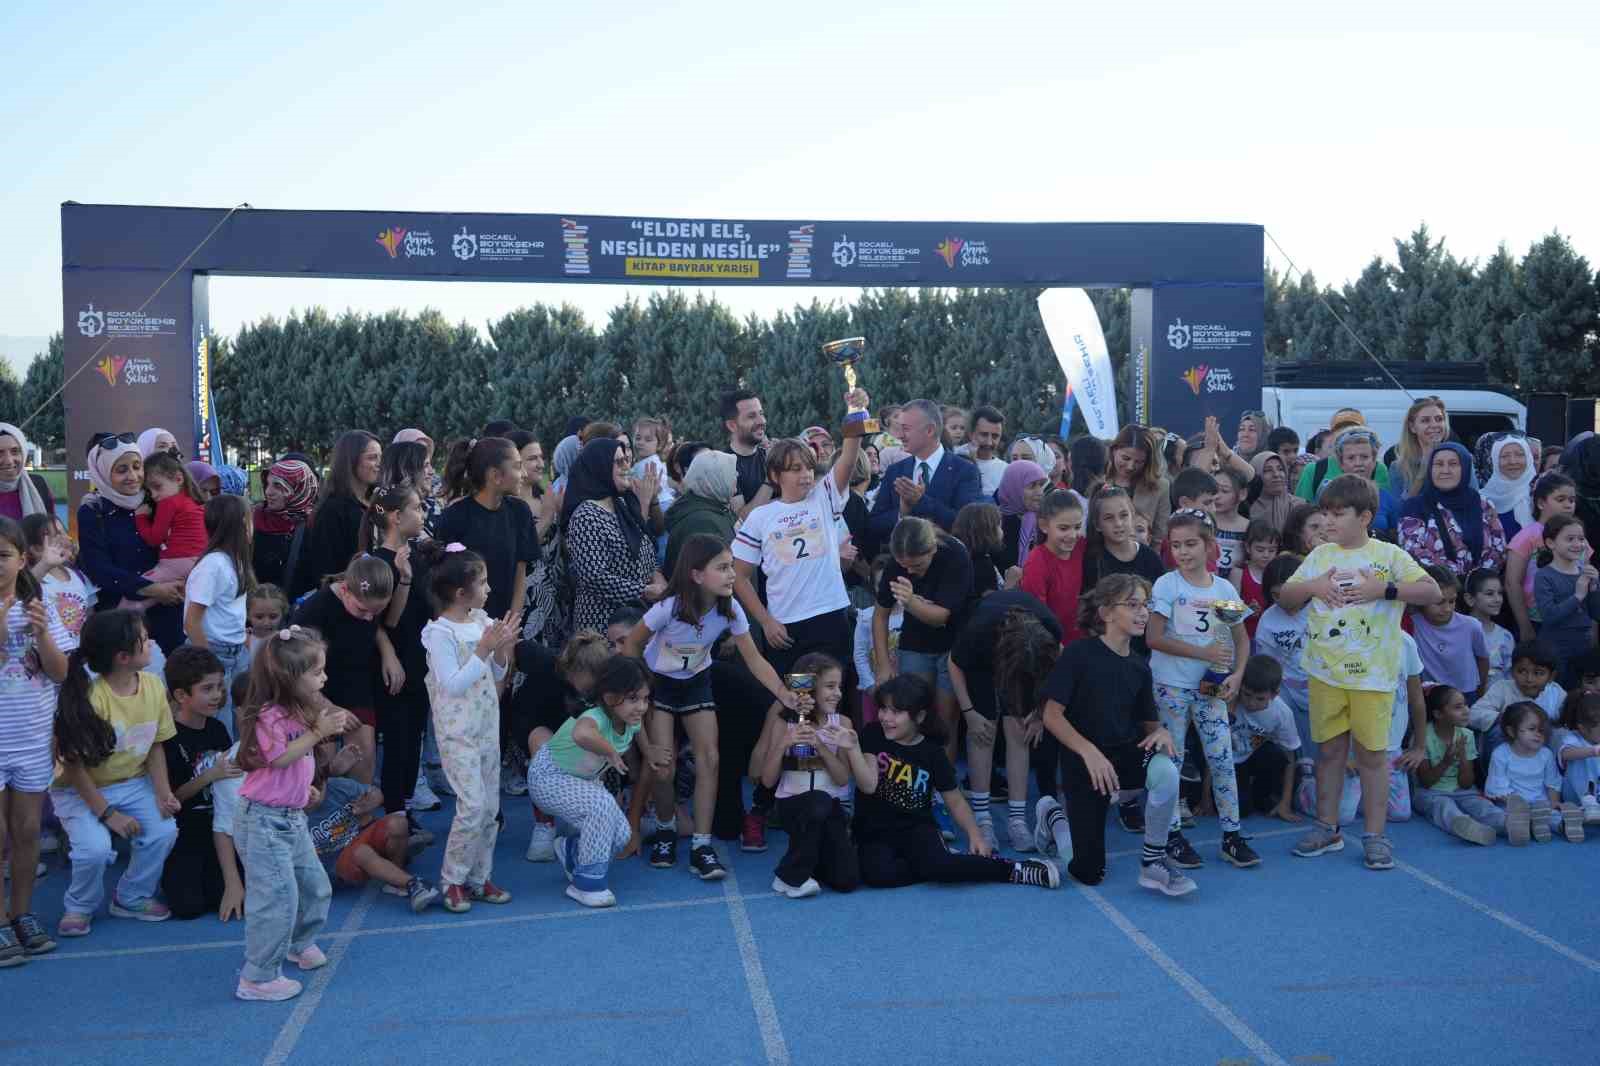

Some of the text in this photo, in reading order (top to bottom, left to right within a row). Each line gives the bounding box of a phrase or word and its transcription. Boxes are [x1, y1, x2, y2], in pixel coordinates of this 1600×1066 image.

[711, 222, 751, 242] ELE,
[600, 238, 697, 257] NESİLDEN
[631, 261, 753, 275] KİTAP BAYRAK YARIŞI
[792, 537, 810, 559] 2
[1220, 548, 1233, 566] 3
[1195, 610, 1210, 633] 3
[681, 655, 689, 671] 1
[878, 751, 930, 793] STAR
